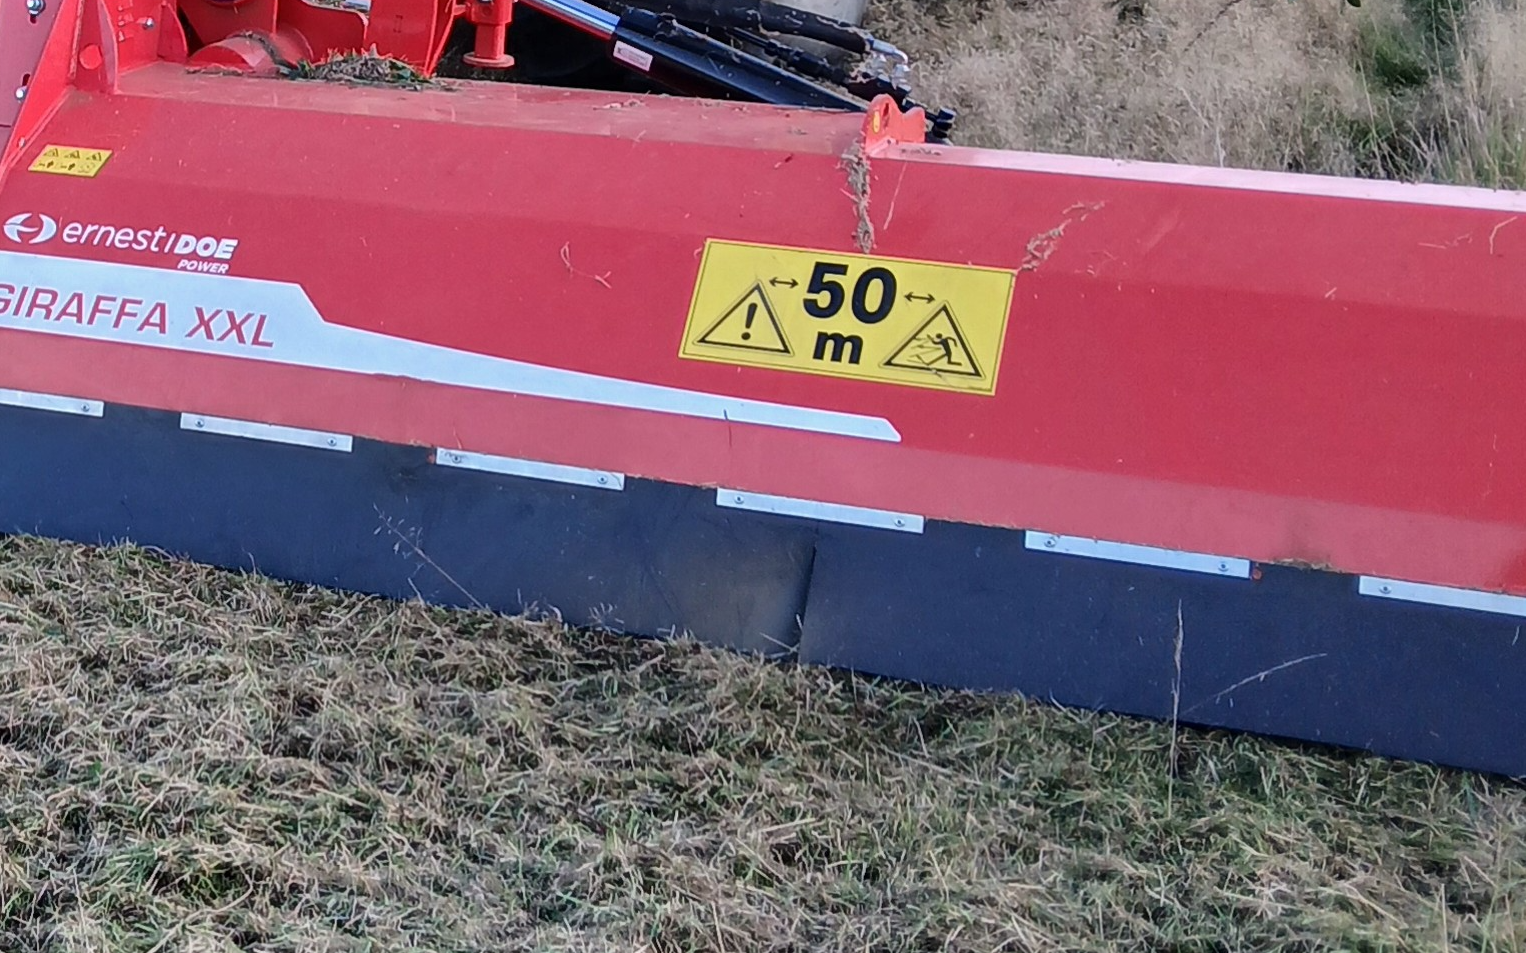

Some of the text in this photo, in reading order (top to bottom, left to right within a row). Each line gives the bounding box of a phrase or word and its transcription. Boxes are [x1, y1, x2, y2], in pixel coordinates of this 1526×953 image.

[177, 259, 230, 274] POWER
[802, 261, 898, 325] 50
[184, 305, 274, 348] XXL
[812, 330, 864, 365] m
